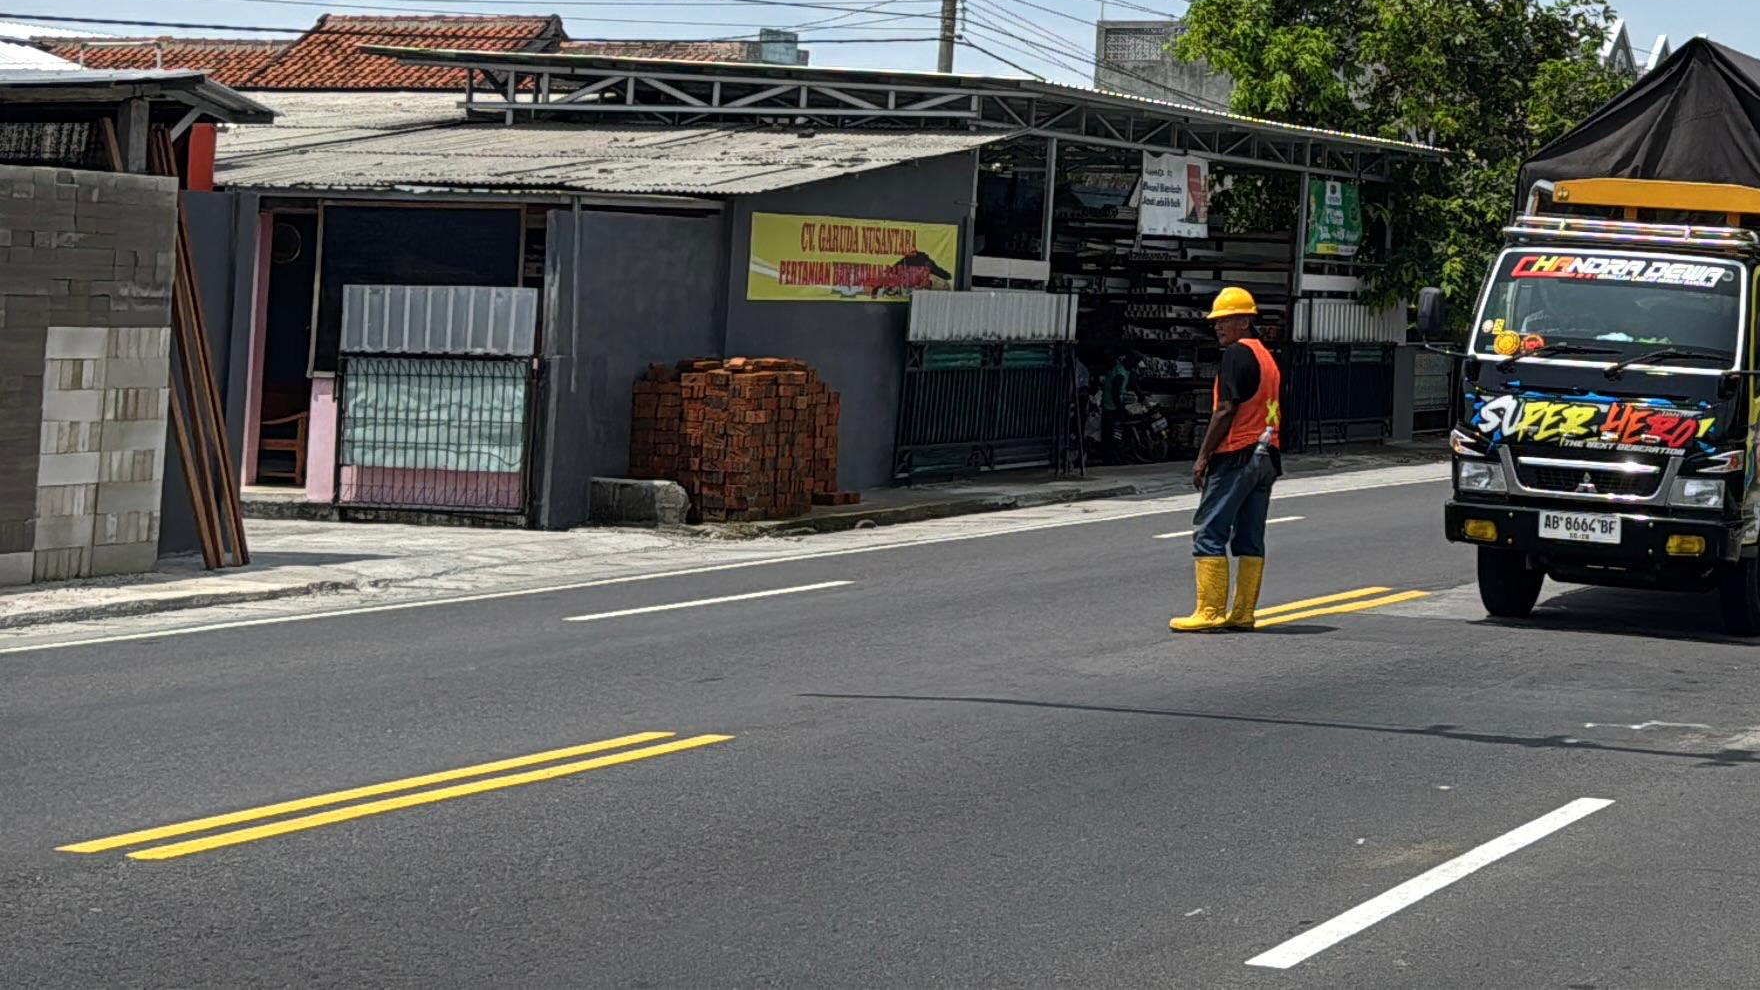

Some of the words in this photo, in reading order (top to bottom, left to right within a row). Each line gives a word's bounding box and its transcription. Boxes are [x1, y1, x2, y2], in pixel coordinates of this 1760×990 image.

[818, 223, 858, 253] GARUDA
[861, 226, 918, 256] NUSANTARA
[779, 260, 831, 285] PERTANIAN
[1511, 255, 1640, 278] CHANDRA
[1645, 262, 1726, 288] DEWA
[1478, 395, 1598, 442] SUPER
[1600, 402, 1698, 448] HERO
[1564, 439, 1584, 448] THE
[1586, 441, 1616, 450] NEXT
[1544, 514, 1560, 530] AB
[1600, 519, 1617, 534] BF
